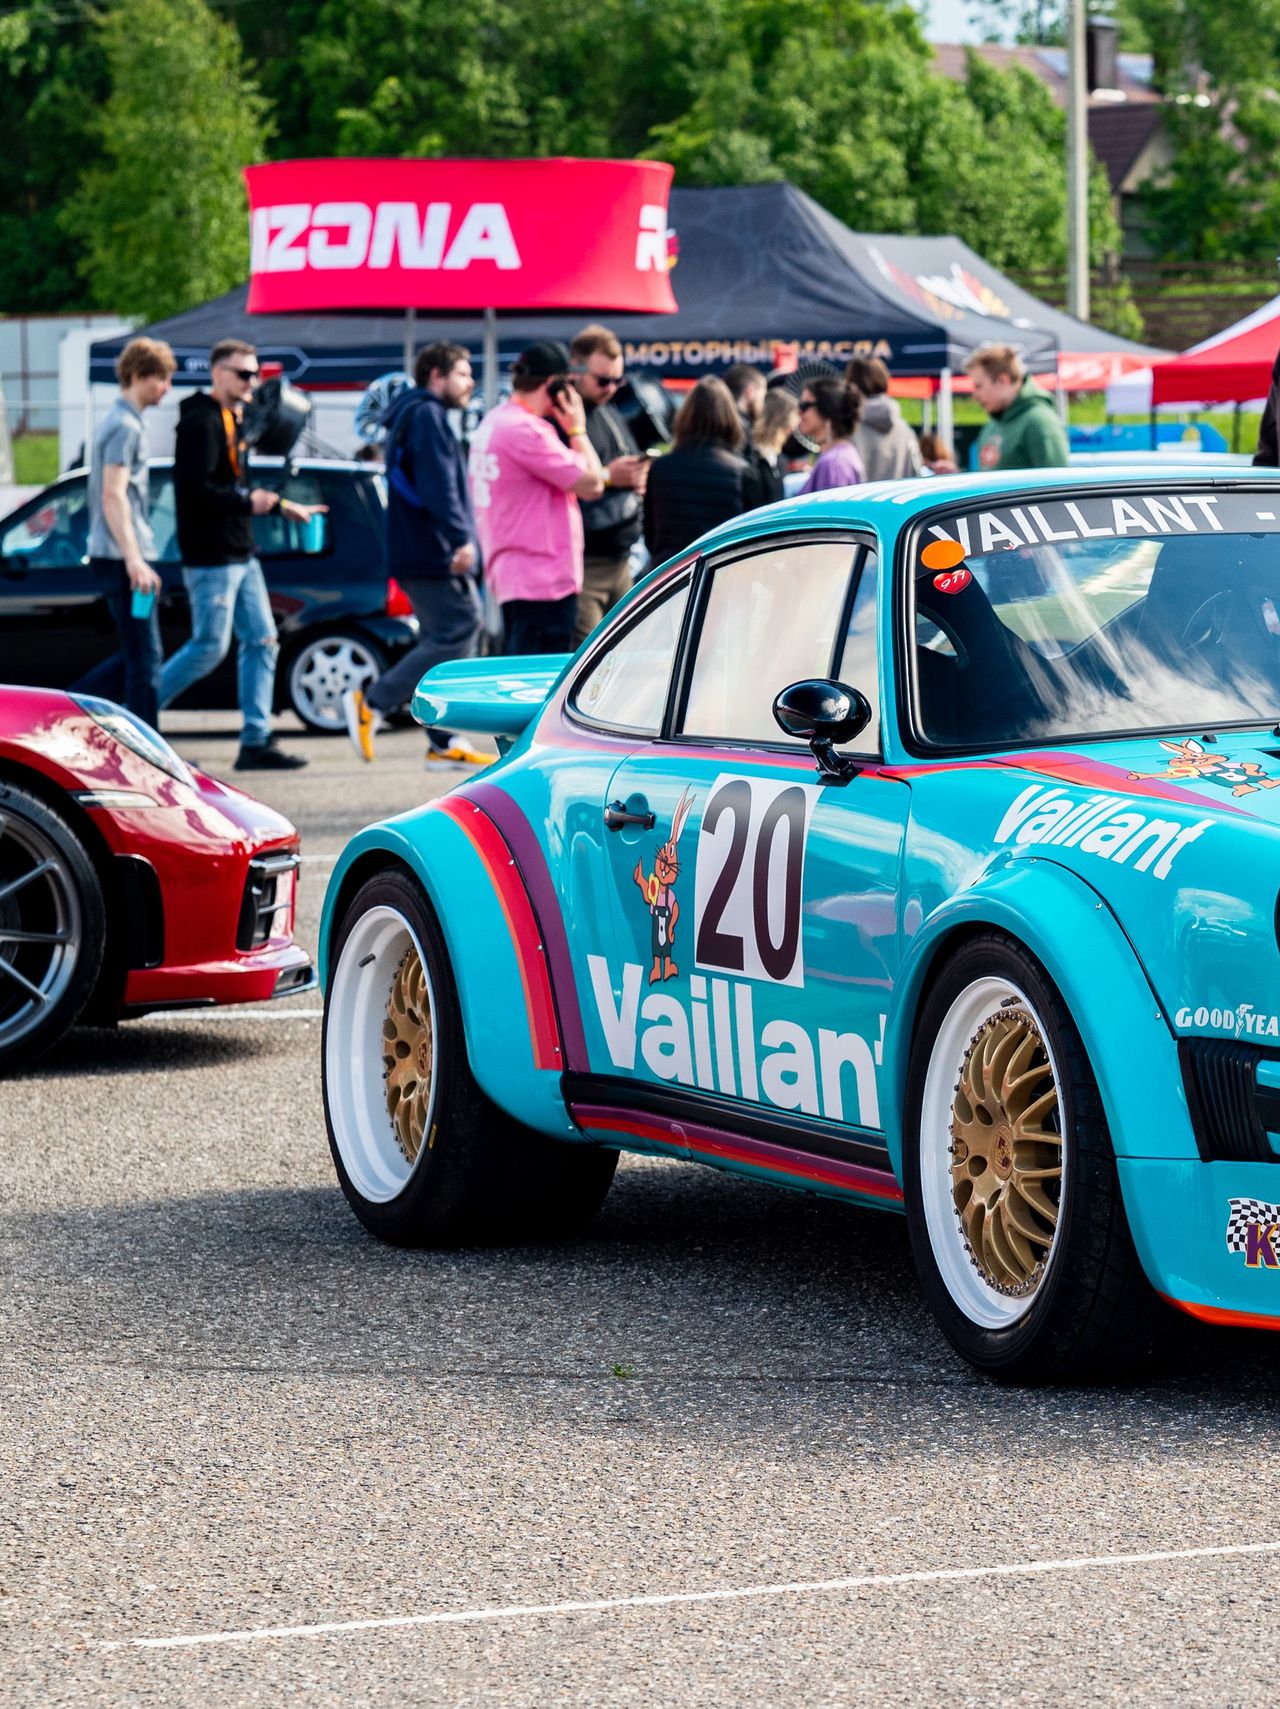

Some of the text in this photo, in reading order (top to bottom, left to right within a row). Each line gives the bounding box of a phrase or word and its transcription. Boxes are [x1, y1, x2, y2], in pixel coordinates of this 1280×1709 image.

[928, 496, 1225, 556] VAILLANT
[941, 570, 966, 590] 911
[993, 784, 1217, 881] Vaillant
[695, 779, 806, 981] 20
